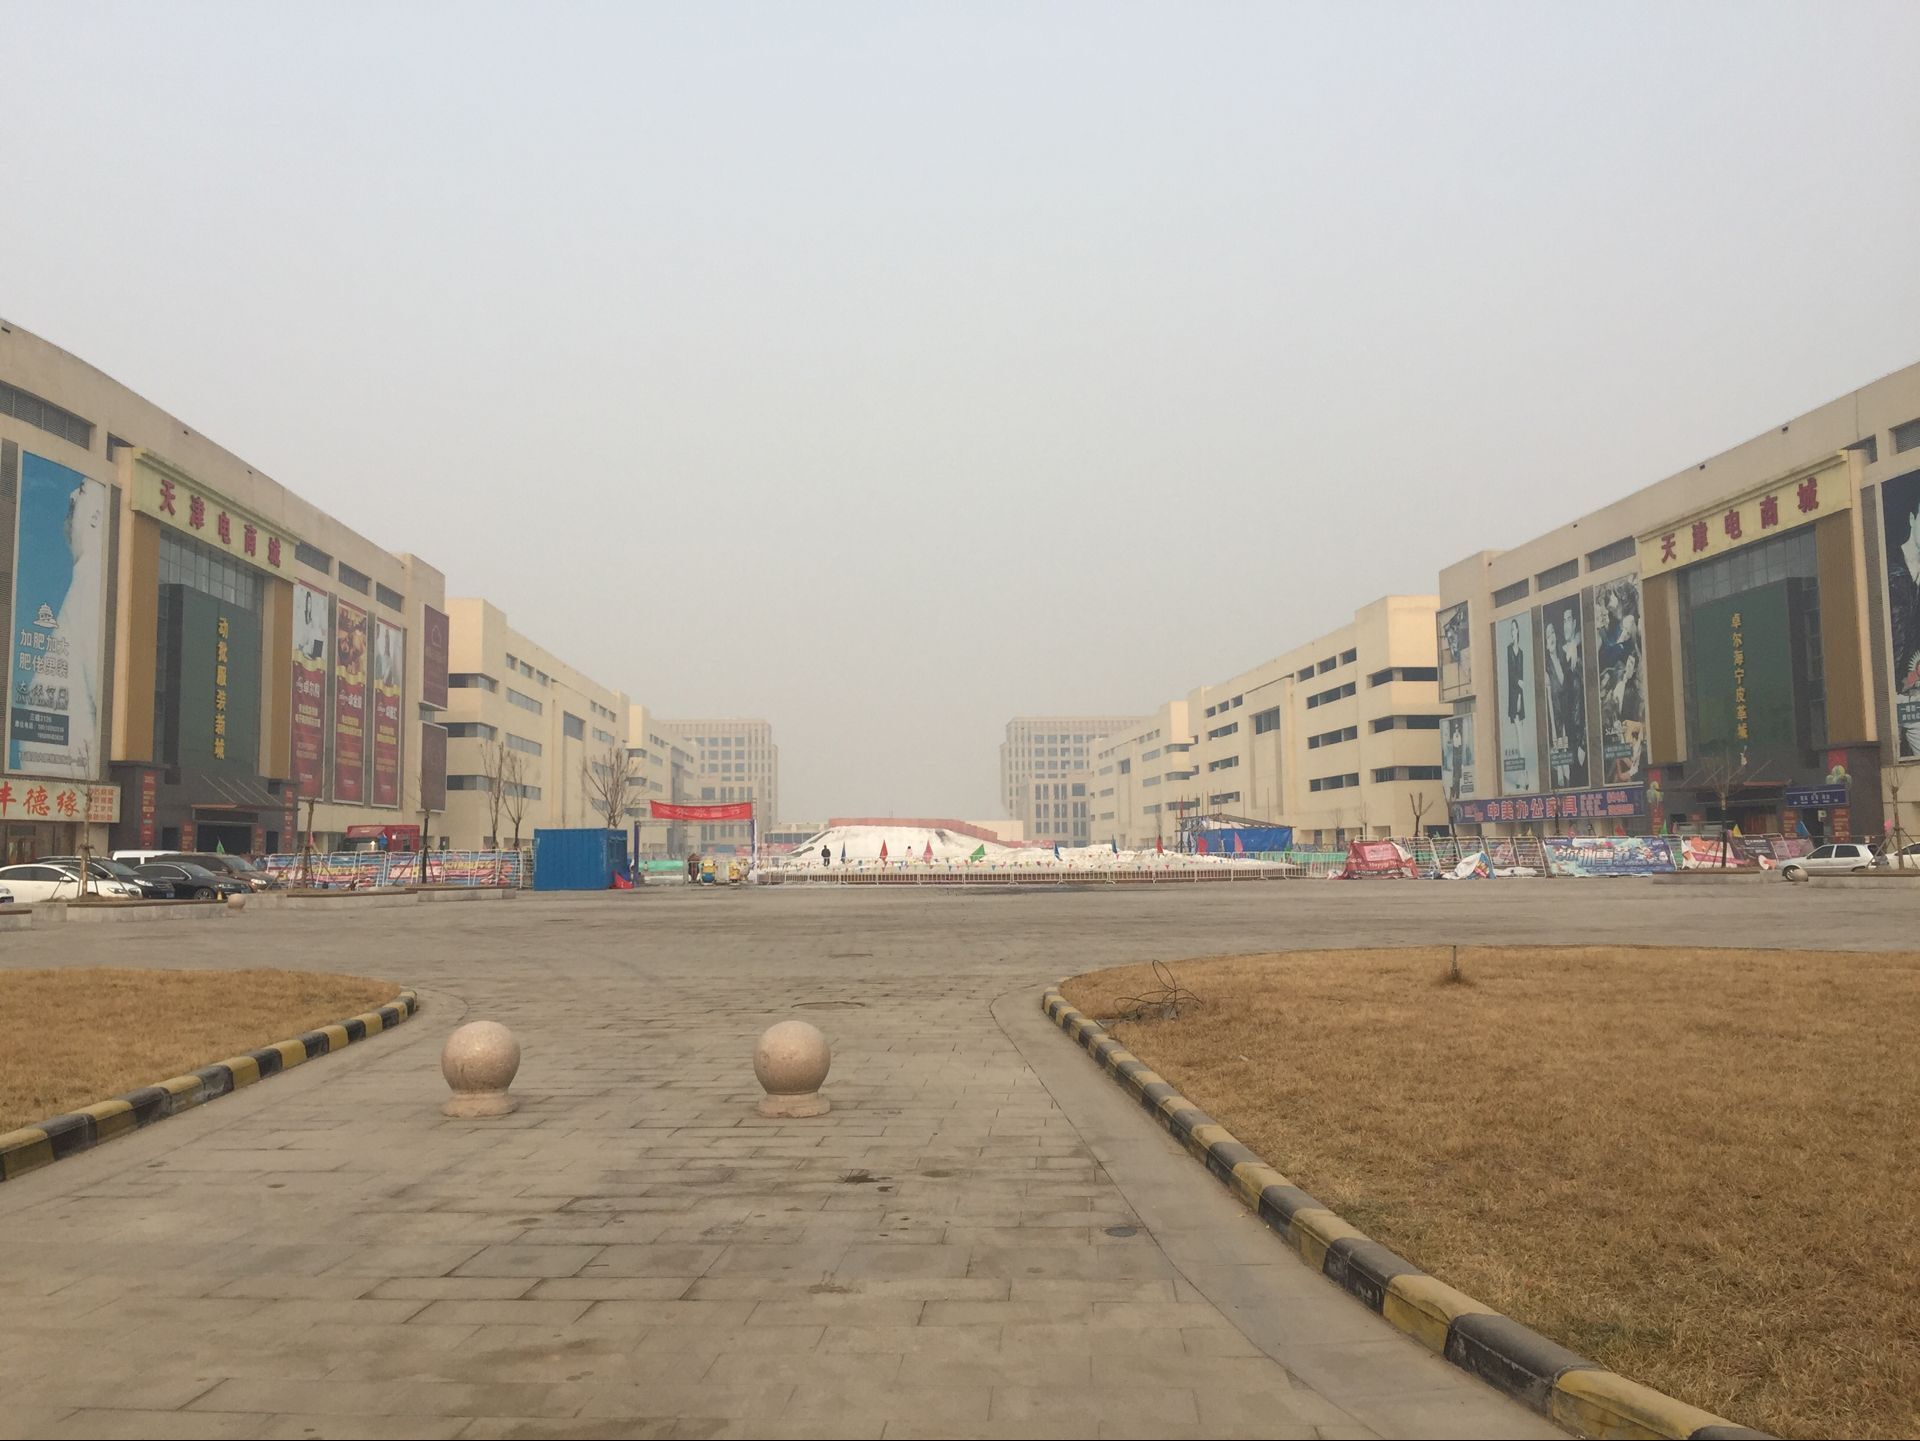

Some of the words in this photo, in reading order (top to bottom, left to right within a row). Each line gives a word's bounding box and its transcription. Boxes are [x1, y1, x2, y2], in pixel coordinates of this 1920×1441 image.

[160, 479, 281, 568] 天津电商城
[1661, 477, 1819, 564] 天津电商城
[20, 629, 69, 656] 加肥加大
[1731, 613, 1748, 738] 卓尔海宁皮革城
